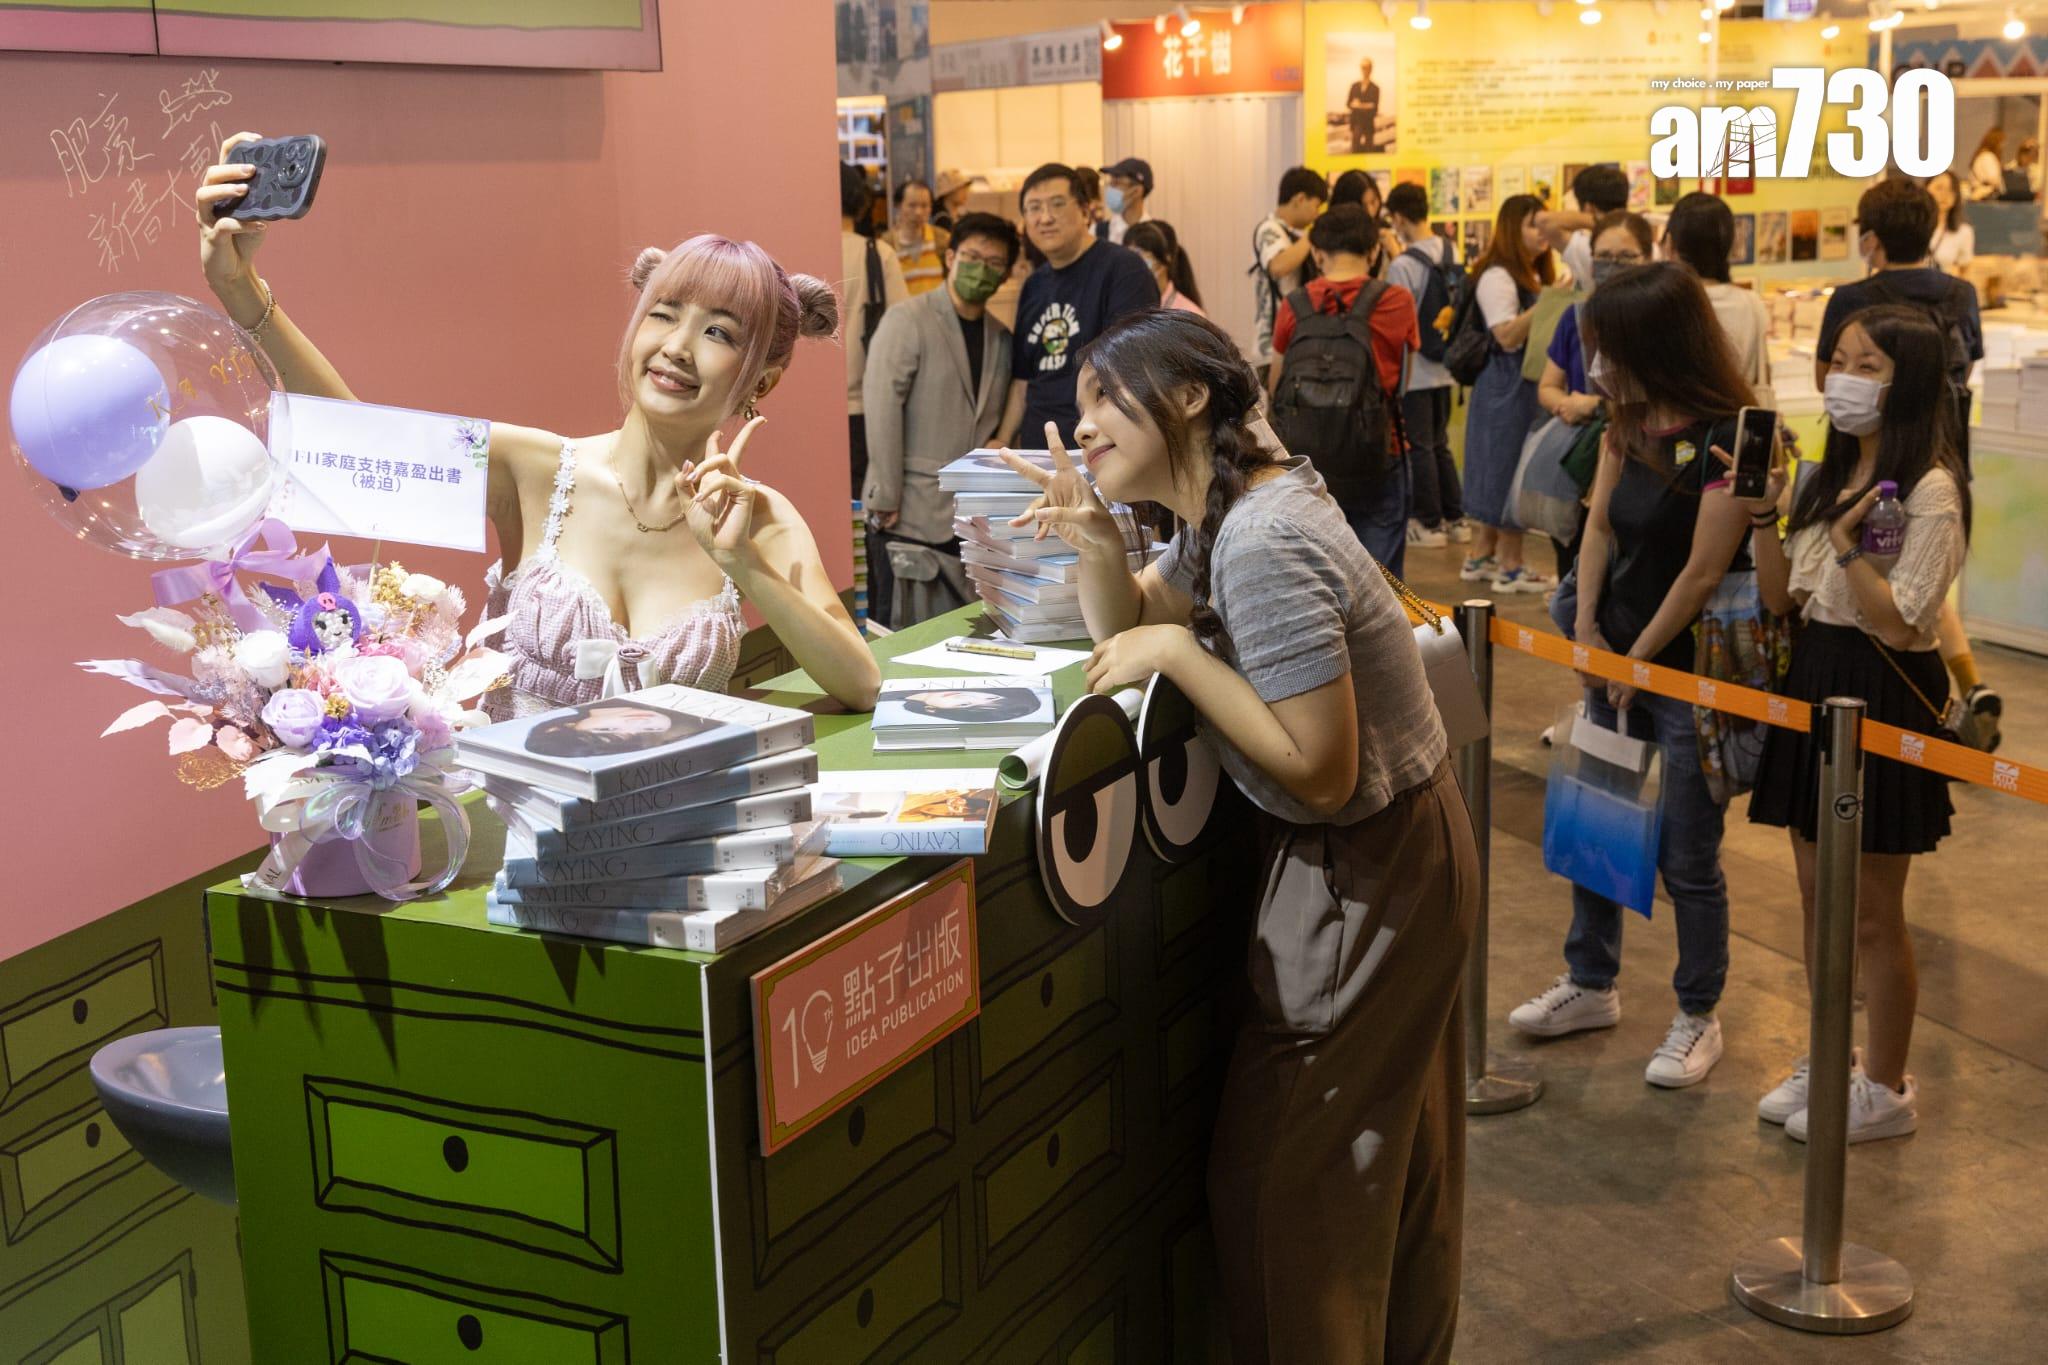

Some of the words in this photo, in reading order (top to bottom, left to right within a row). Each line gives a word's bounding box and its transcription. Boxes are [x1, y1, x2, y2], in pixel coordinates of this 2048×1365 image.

[1162, 30, 1232, 80] 花千樹
[617, 757, 692, 793] KAYING
[588, 791, 674, 821] KAYING
[565, 822, 655, 853] KAYING
[880, 831, 961, 851] KAYING
[536, 855, 628, 883] KAYING
[522, 883, 606, 903] KAYING
[508, 904, 580, 931] KAYING
[842, 908, 962, 1030] 點子出版
[846, 1024, 878, 1059] IDEA
[881, 967, 964, 1037] PUBLICATION
